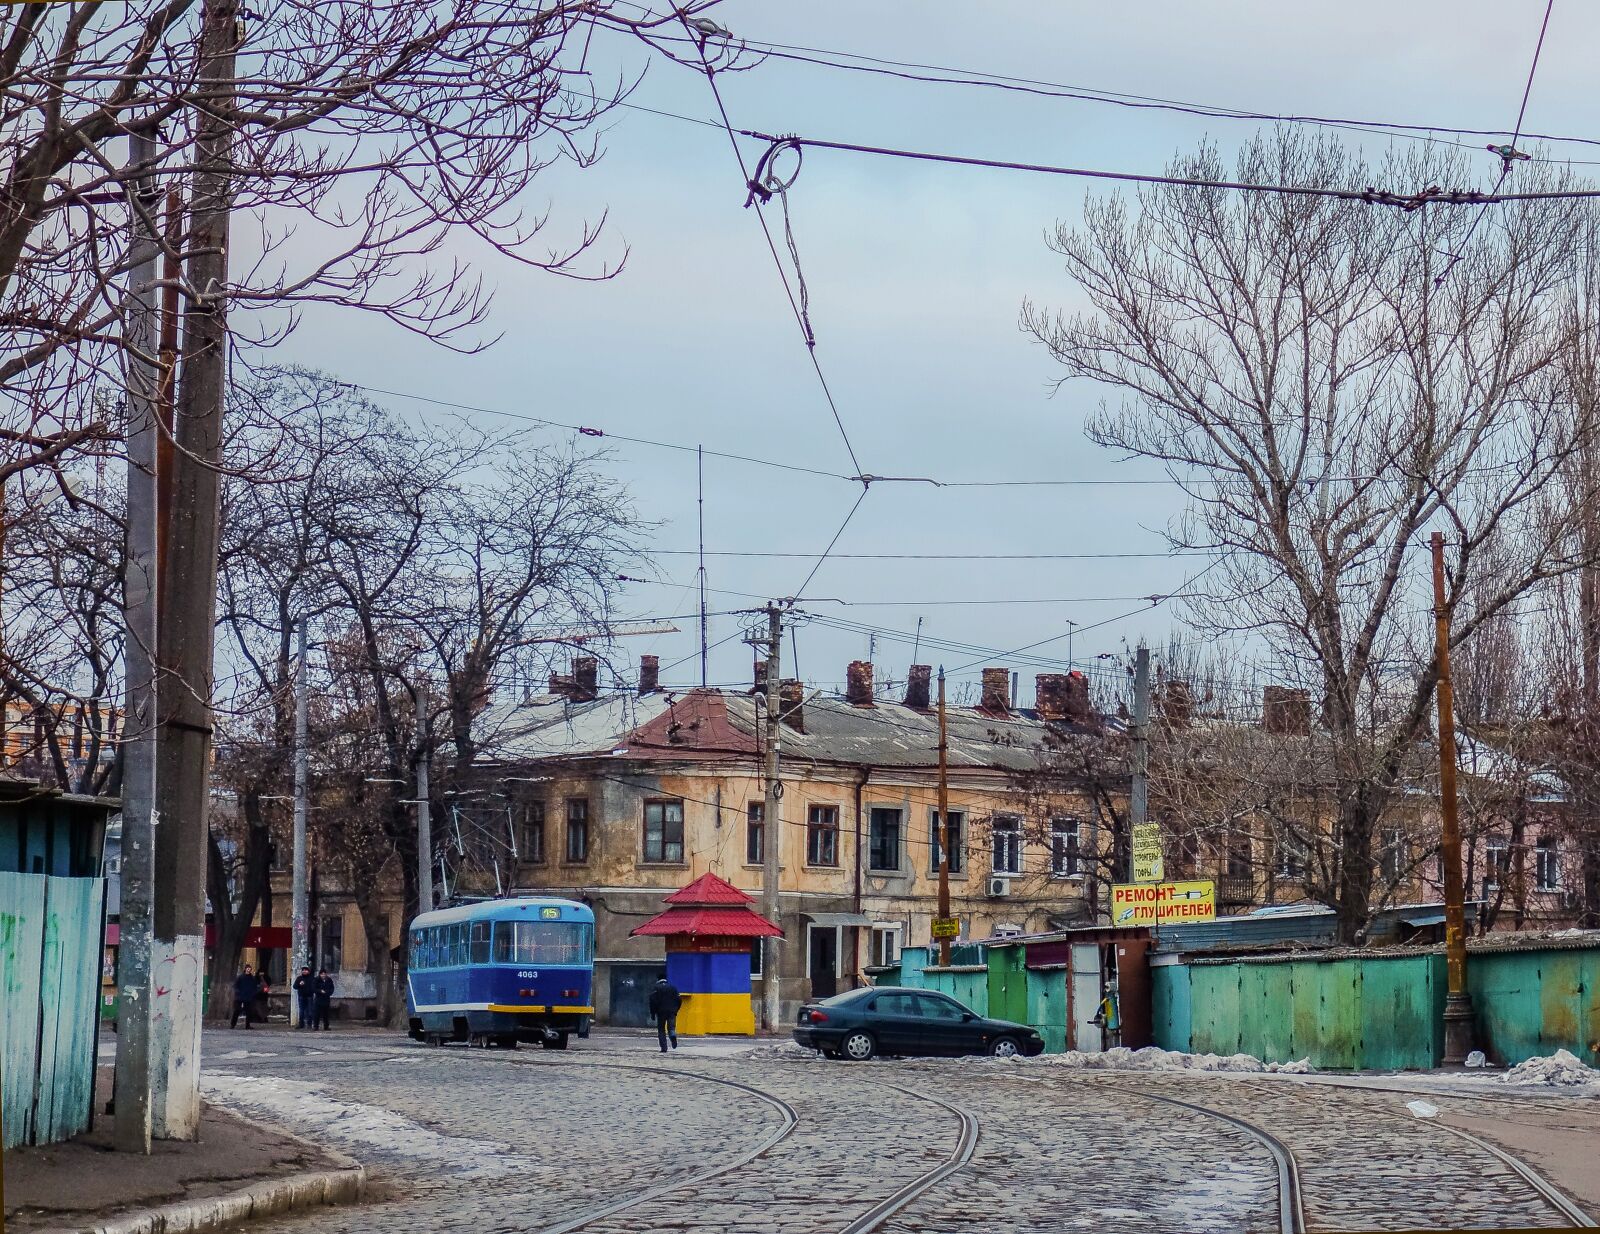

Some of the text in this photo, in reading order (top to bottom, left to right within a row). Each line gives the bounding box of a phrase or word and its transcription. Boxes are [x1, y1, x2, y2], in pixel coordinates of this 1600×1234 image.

[1135, 868, 1152, 878] ГОФРЫ
[1115, 886, 1176, 903] РЕМОНТ
[543, 908, 558, 919] 15
[1134, 901, 1213, 919] ГЛУШИТЕЛЕЙ
[517, 971, 538, 979] 4063
